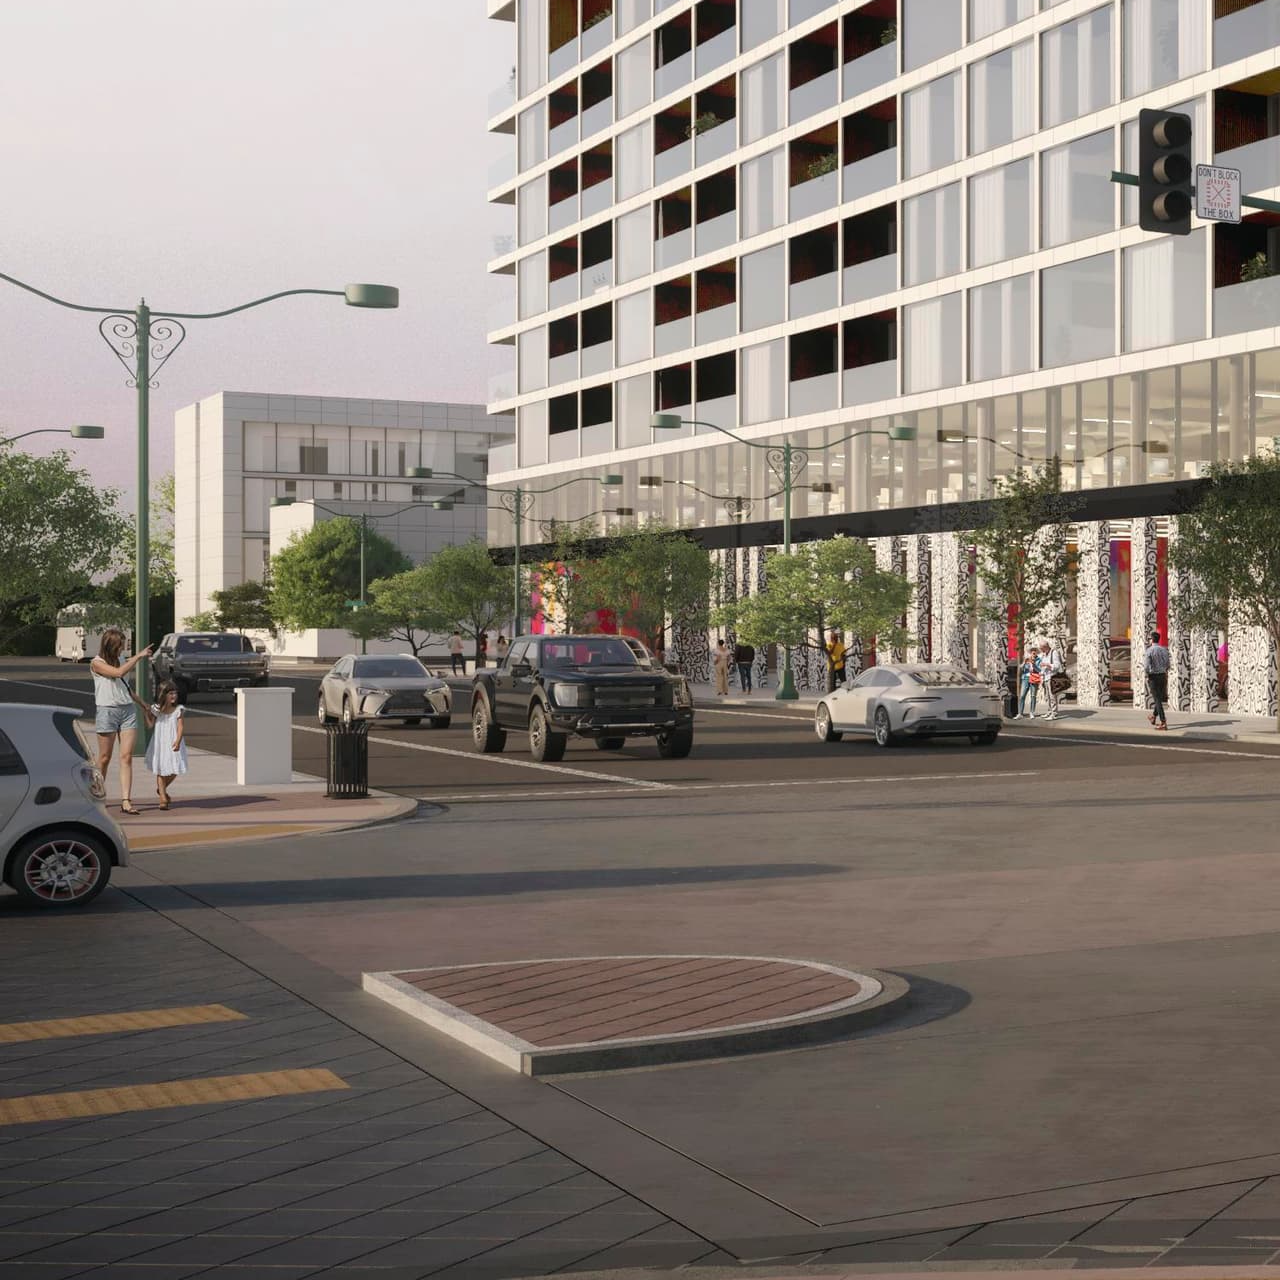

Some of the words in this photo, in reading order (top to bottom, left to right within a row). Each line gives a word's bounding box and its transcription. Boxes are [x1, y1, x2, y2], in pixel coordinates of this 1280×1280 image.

[1218, 170, 1239, 181] BLOCK
[1204, 207, 1216, 217] THE
[1219, 209, 1233, 219] BOX
